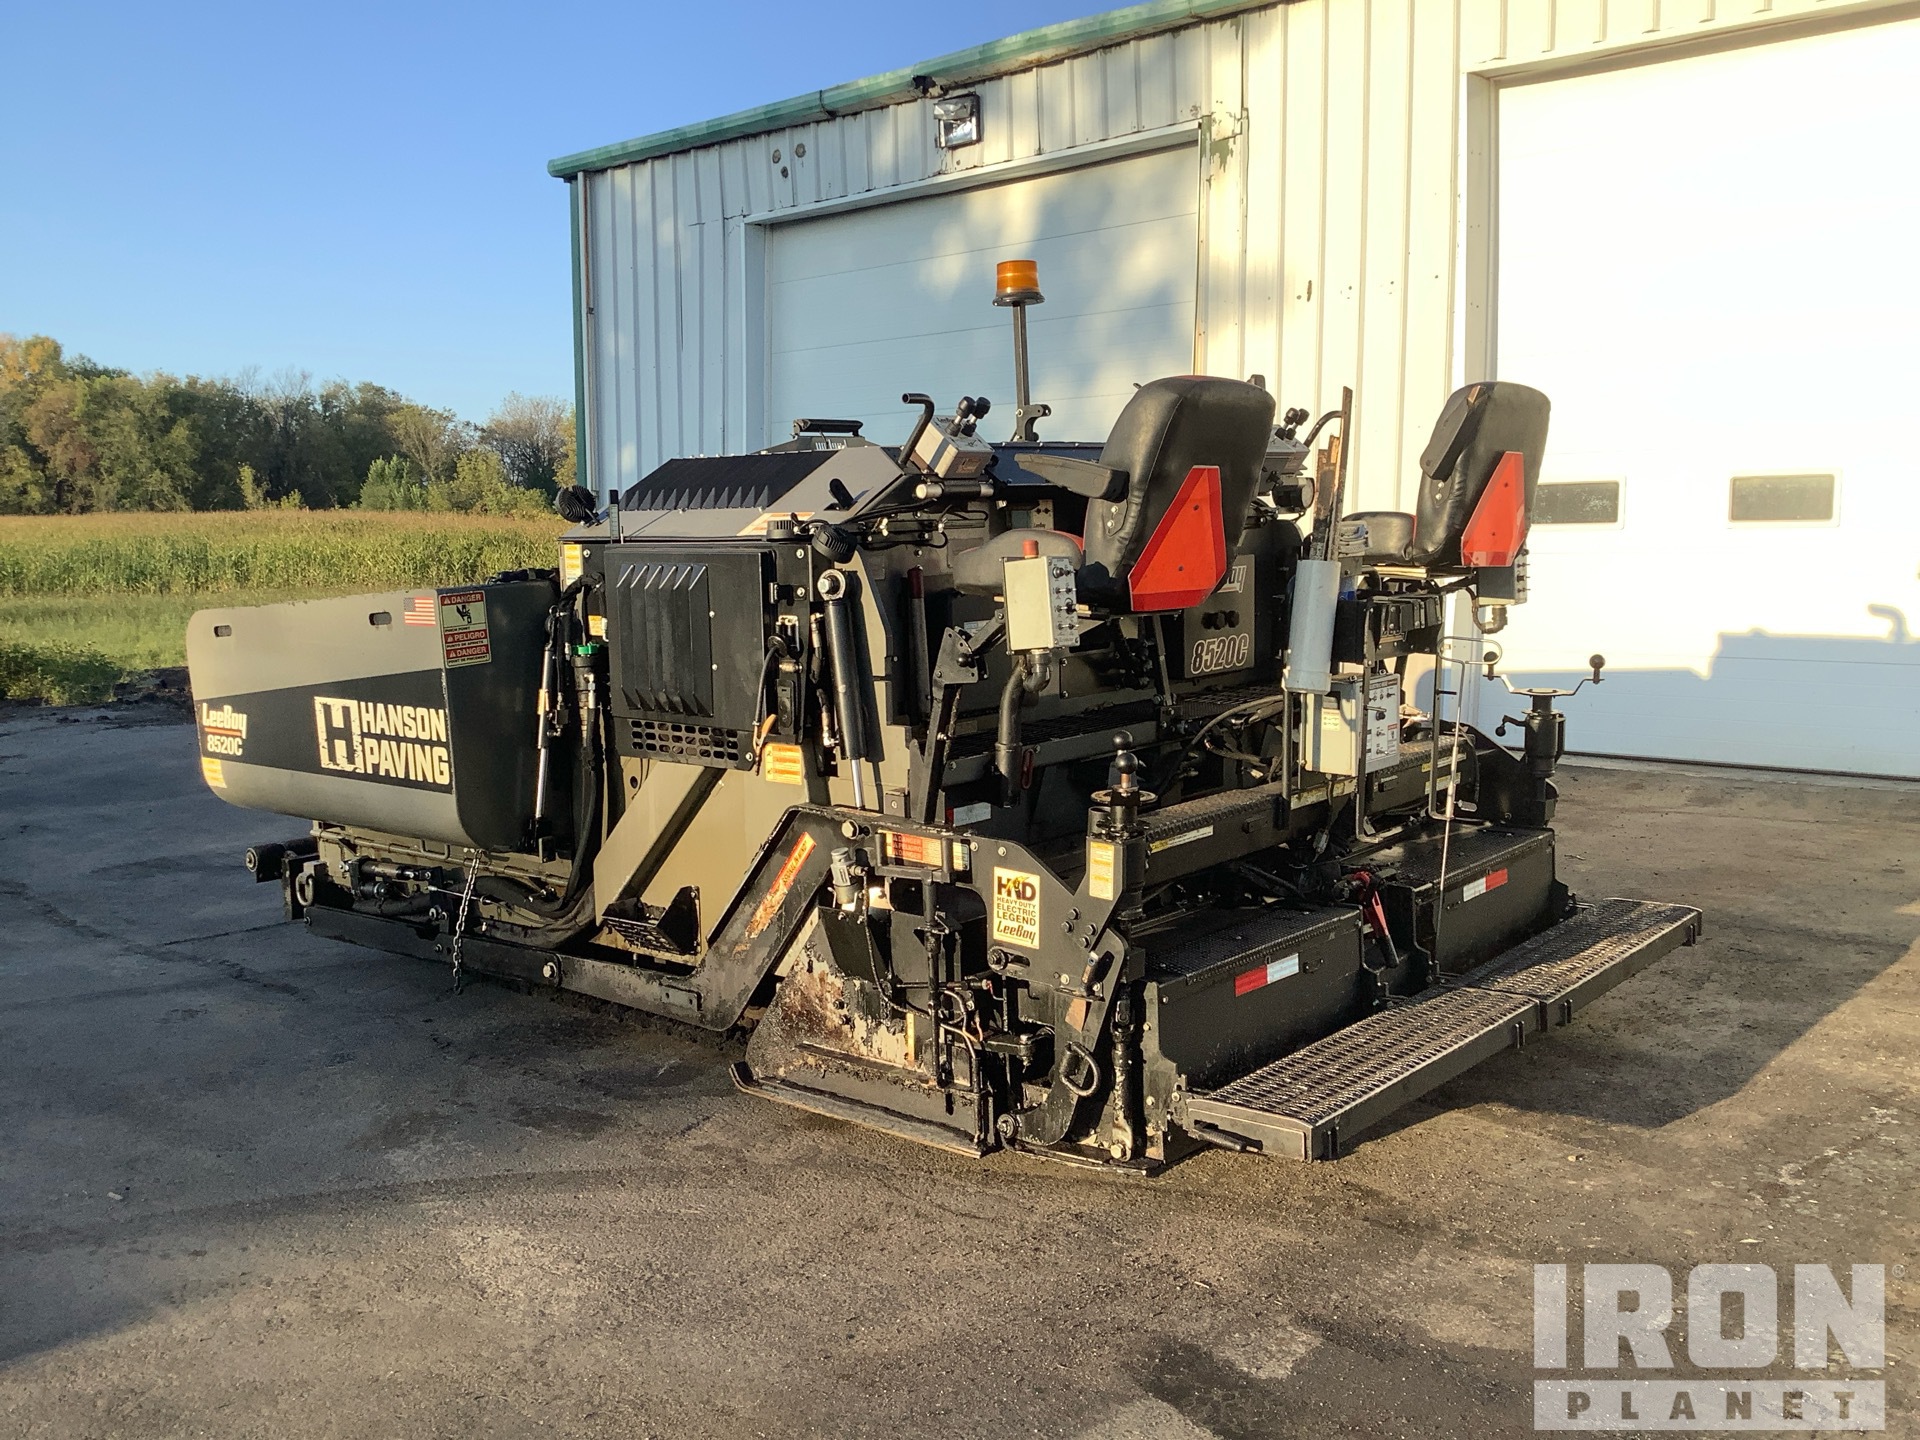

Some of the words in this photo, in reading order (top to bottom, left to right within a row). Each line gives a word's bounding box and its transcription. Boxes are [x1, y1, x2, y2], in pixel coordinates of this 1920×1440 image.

[451, 593, 482, 604] DANGER
[454, 631, 486, 642] PELIGRO
[456, 647, 487, 658] DANGER
[1190, 633, 1250, 675] 8520C
[202, 702, 247, 740] LeeBoy
[360, 701, 447, 742] HANSON
[207, 734, 243, 756] 8520C
[363, 737, 450, 785] PAVING
[997, 896, 1018, 906] HEAVY
[1018, 901, 1037, 910] DUTY
[997, 903, 1037, 918] ELECTRIC
[997, 910, 1037, 927] LEGEND
[997, 920, 1037, 945] LeeBoy
